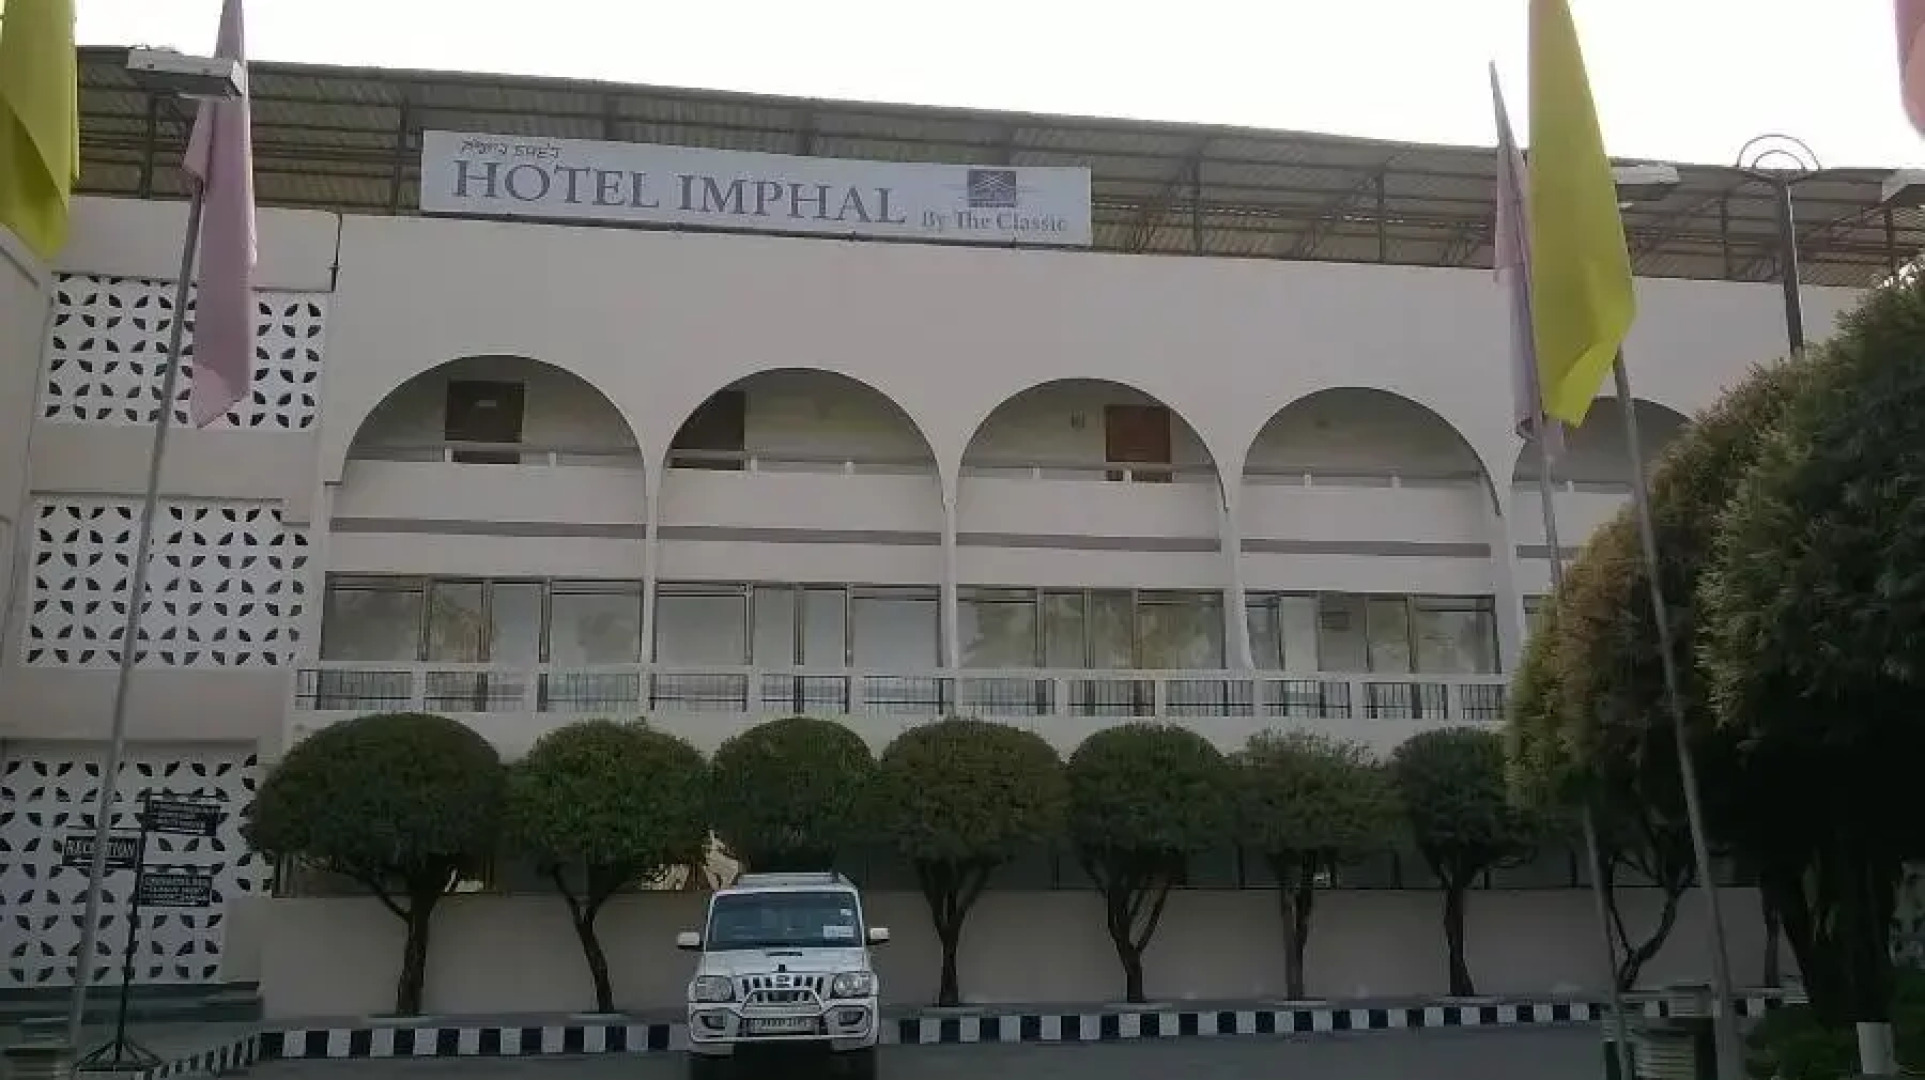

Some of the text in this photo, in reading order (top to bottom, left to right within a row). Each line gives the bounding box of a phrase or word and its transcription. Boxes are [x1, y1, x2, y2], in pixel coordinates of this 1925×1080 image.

[453, 159, 907, 224] HOTEL IMPHAL
[923, 210, 1067, 232] By The Classic
